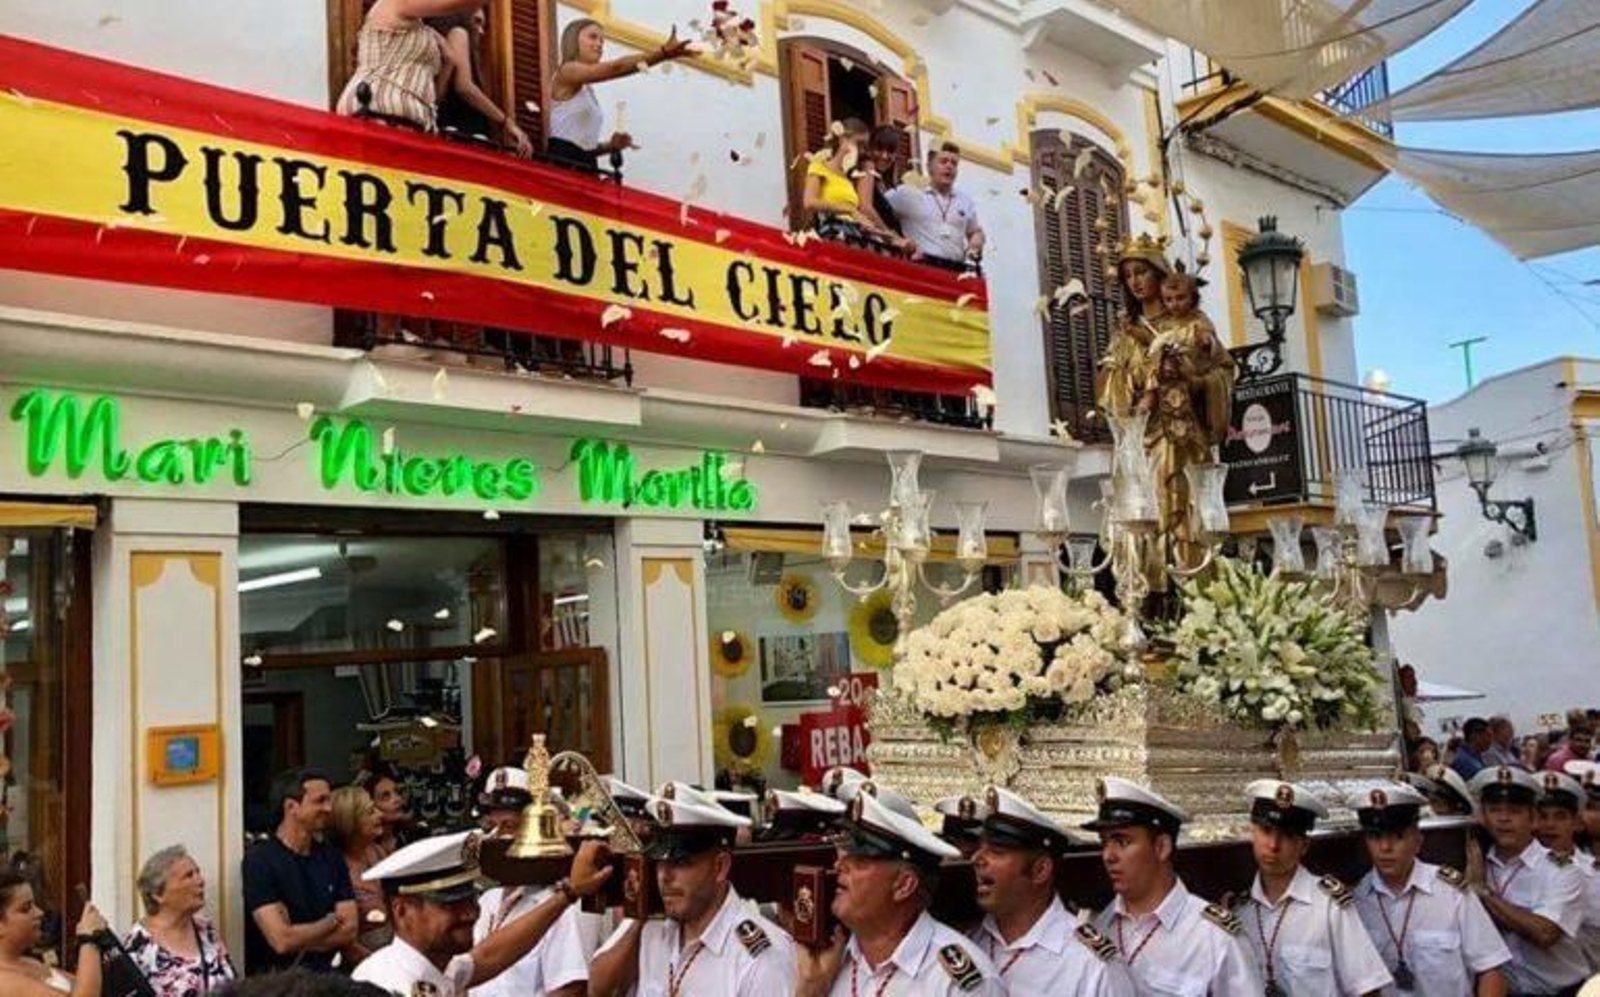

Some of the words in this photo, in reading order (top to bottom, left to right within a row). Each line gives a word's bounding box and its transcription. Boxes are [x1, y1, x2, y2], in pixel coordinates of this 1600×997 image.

[116, 130, 524, 271] PUERTA
[550, 215, 695, 310] DEL
[727, 259, 893, 346] CIELO
[10, 388, 251, 487] Mari
[309, 416, 535, 501] Nieves
[810, 724, 866, 768] REBA
